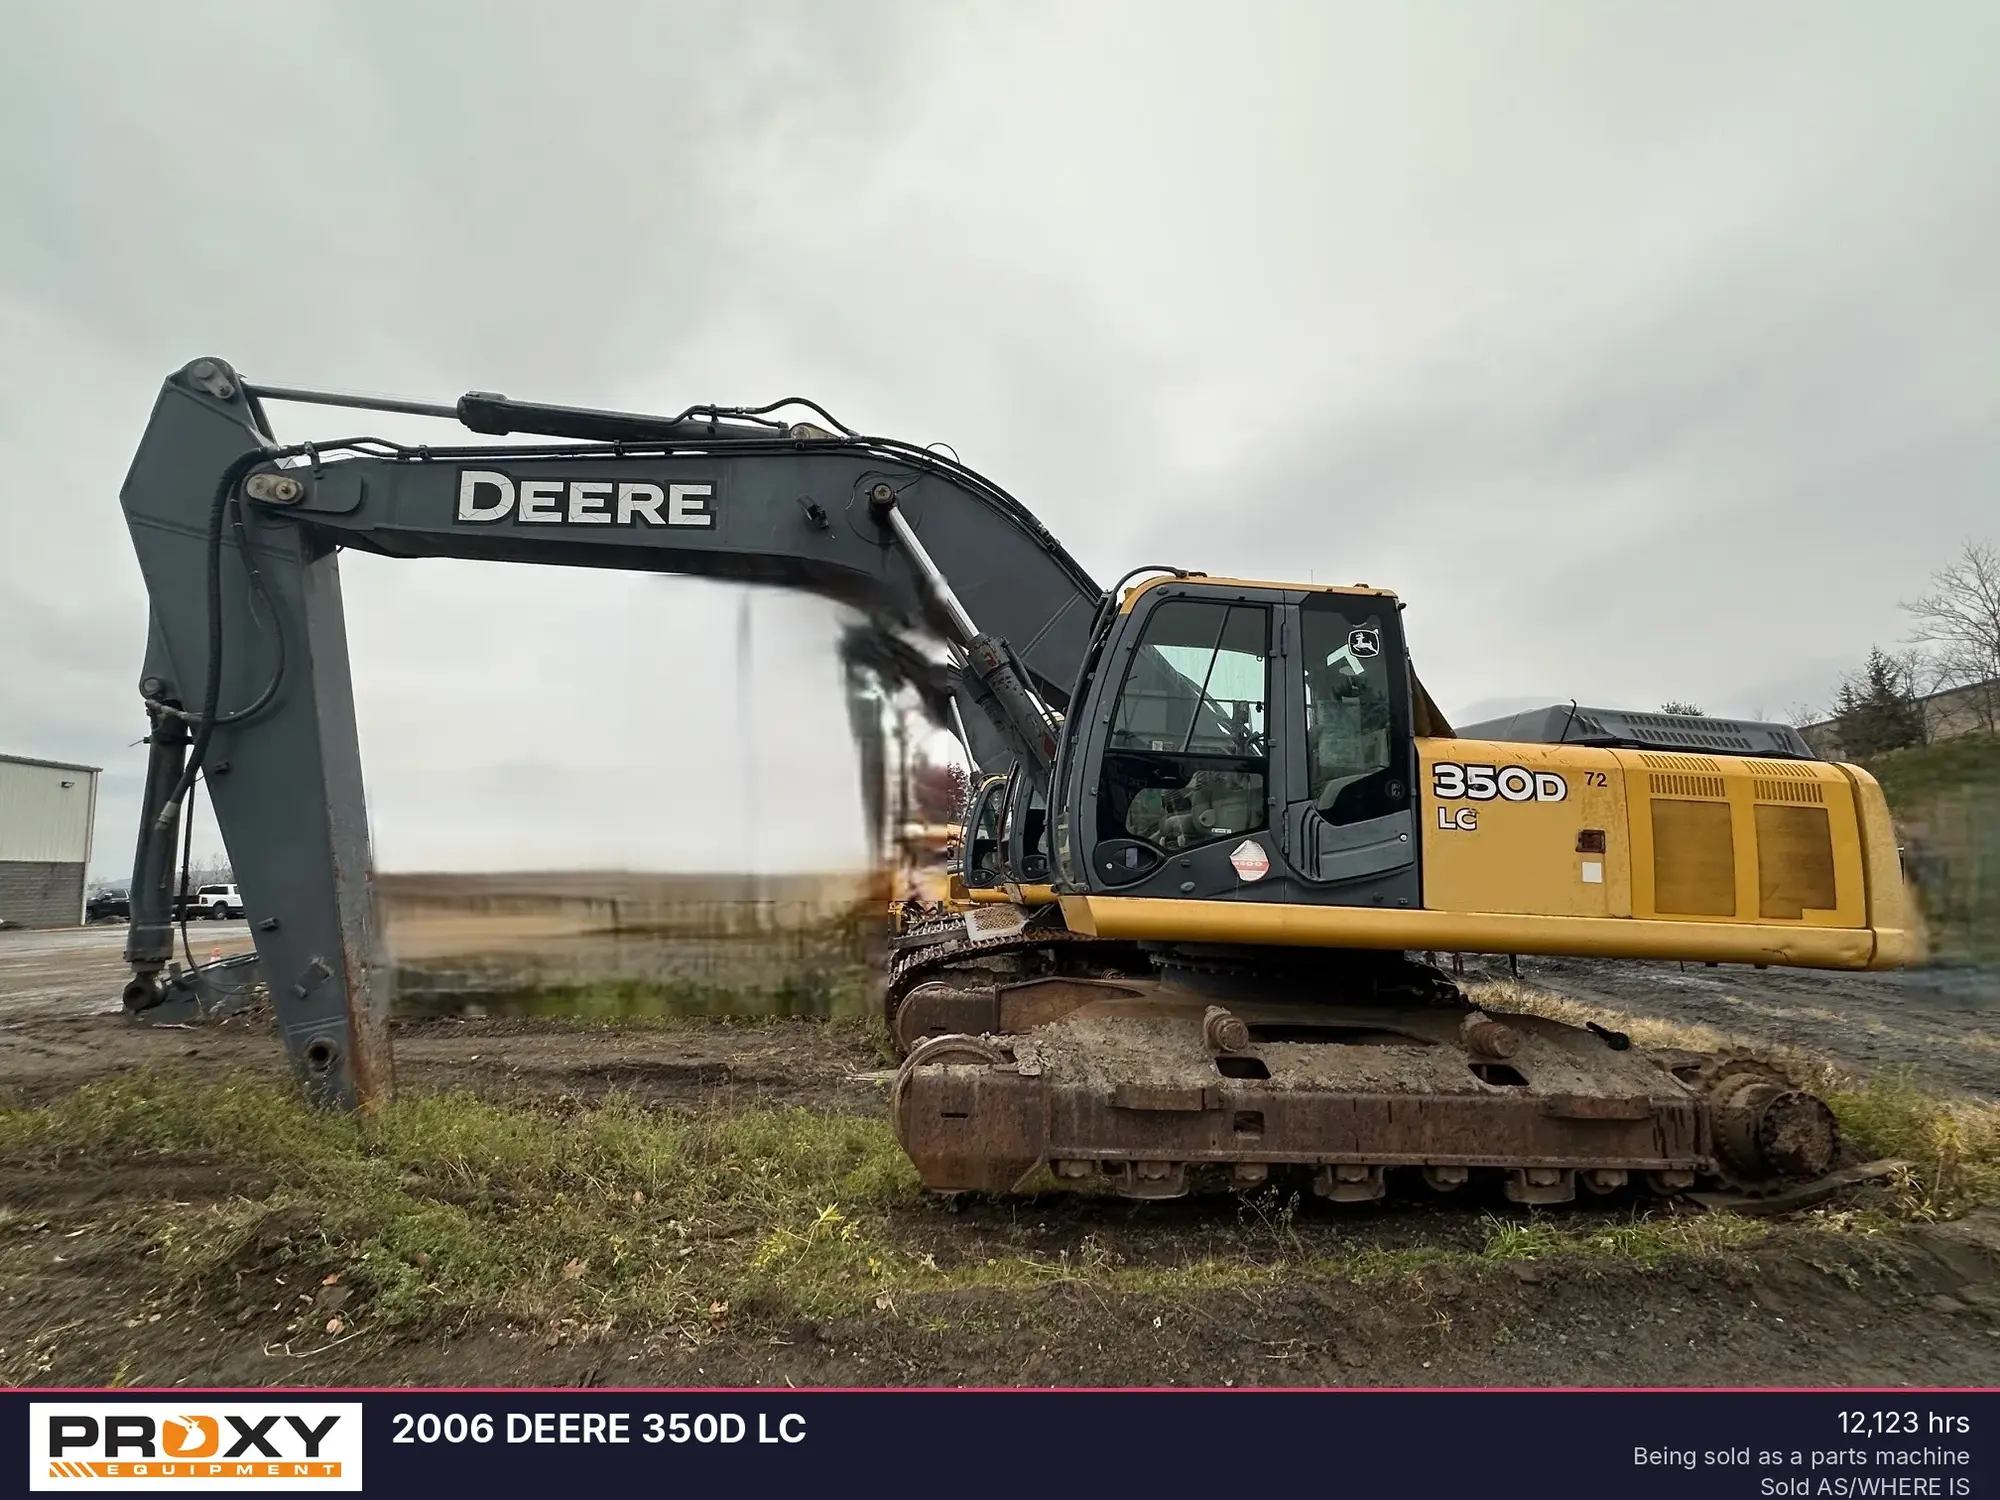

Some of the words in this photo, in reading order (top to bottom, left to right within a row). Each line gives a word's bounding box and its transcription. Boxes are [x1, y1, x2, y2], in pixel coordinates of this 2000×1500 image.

[457, 469, 713, 526] DEERE
[1433, 762, 1567, 802] 350D
[1584, 771, 1608, 788] 72
[1438, 807, 1477, 830] LC
